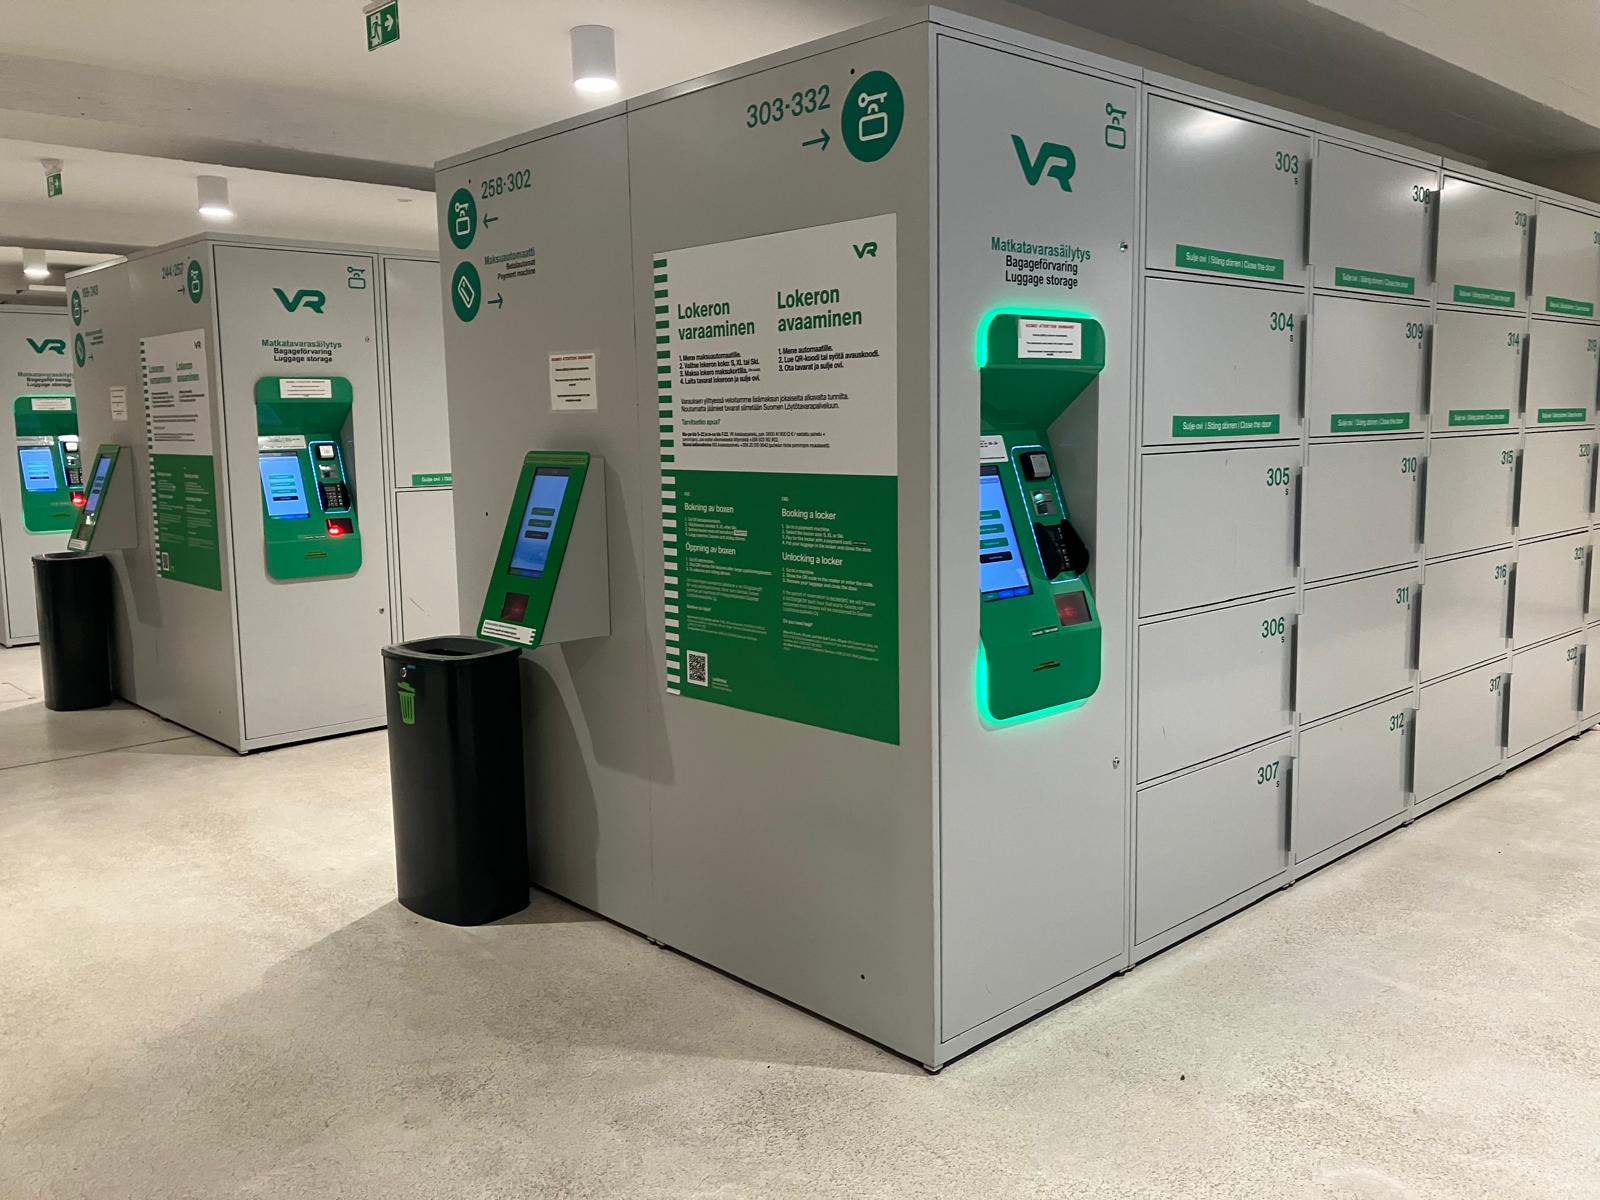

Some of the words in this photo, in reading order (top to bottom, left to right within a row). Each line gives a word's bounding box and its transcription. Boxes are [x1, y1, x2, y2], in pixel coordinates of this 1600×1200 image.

[1010, 134, 1077, 193] VR
[1275, 151, 1299, 174] 303
[1412, 185, 1431, 204] 308
[852, 242, 879, 259] VR
[991, 236, 1092, 263] Matkatavarasäilytys
[1005, 254, 1079, 275] Bagageförvaring
[1005, 270, 1044, 287] Luggage
[1046, 274, 1079, 290] storage
[272, 288, 326, 314] VR
[777, 288, 841, 310] Lokeron
[678, 302, 730, 320] Lokeron
[778, 309, 863, 332] avaaminen
[678, 320, 755, 341] varaaminen
[1270, 312, 1294, 332] 304
[1405, 323, 1424, 339] 309
[26, 338, 66, 355] VR
[273, 347, 333, 357] Bagageförvaring
[273, 355, 305, 363] Luggage
[306, 355, 333, 363] storage
[1401, 457, 1417, 473] 310
[1501, 450, 1514, 465] 315
[1267, 467, 1290, 486] 305
[684, 502, 708, 513] Bokning
[716, 504, 734, 513] boxen
[781, 508, 809, 520] Booking
[809, 511, 814, 519] a
[815, 510, 837, 520] locker
[685, 541, 709, 555] Öppning
[718, 545, 736, 555] boxen
[782, 551, 815, 566] Unlocking
[815, 556, 821, 564] a
[821, 555, 843, 567] locker
[1396, 586, 1409, 605] 311
[1262, 616, 1285, 638] 306
[1489, 675, 1501, 692] 317
[1389, 712, 1404, 731] 312
[1257, 760, 1280, 784] 307
